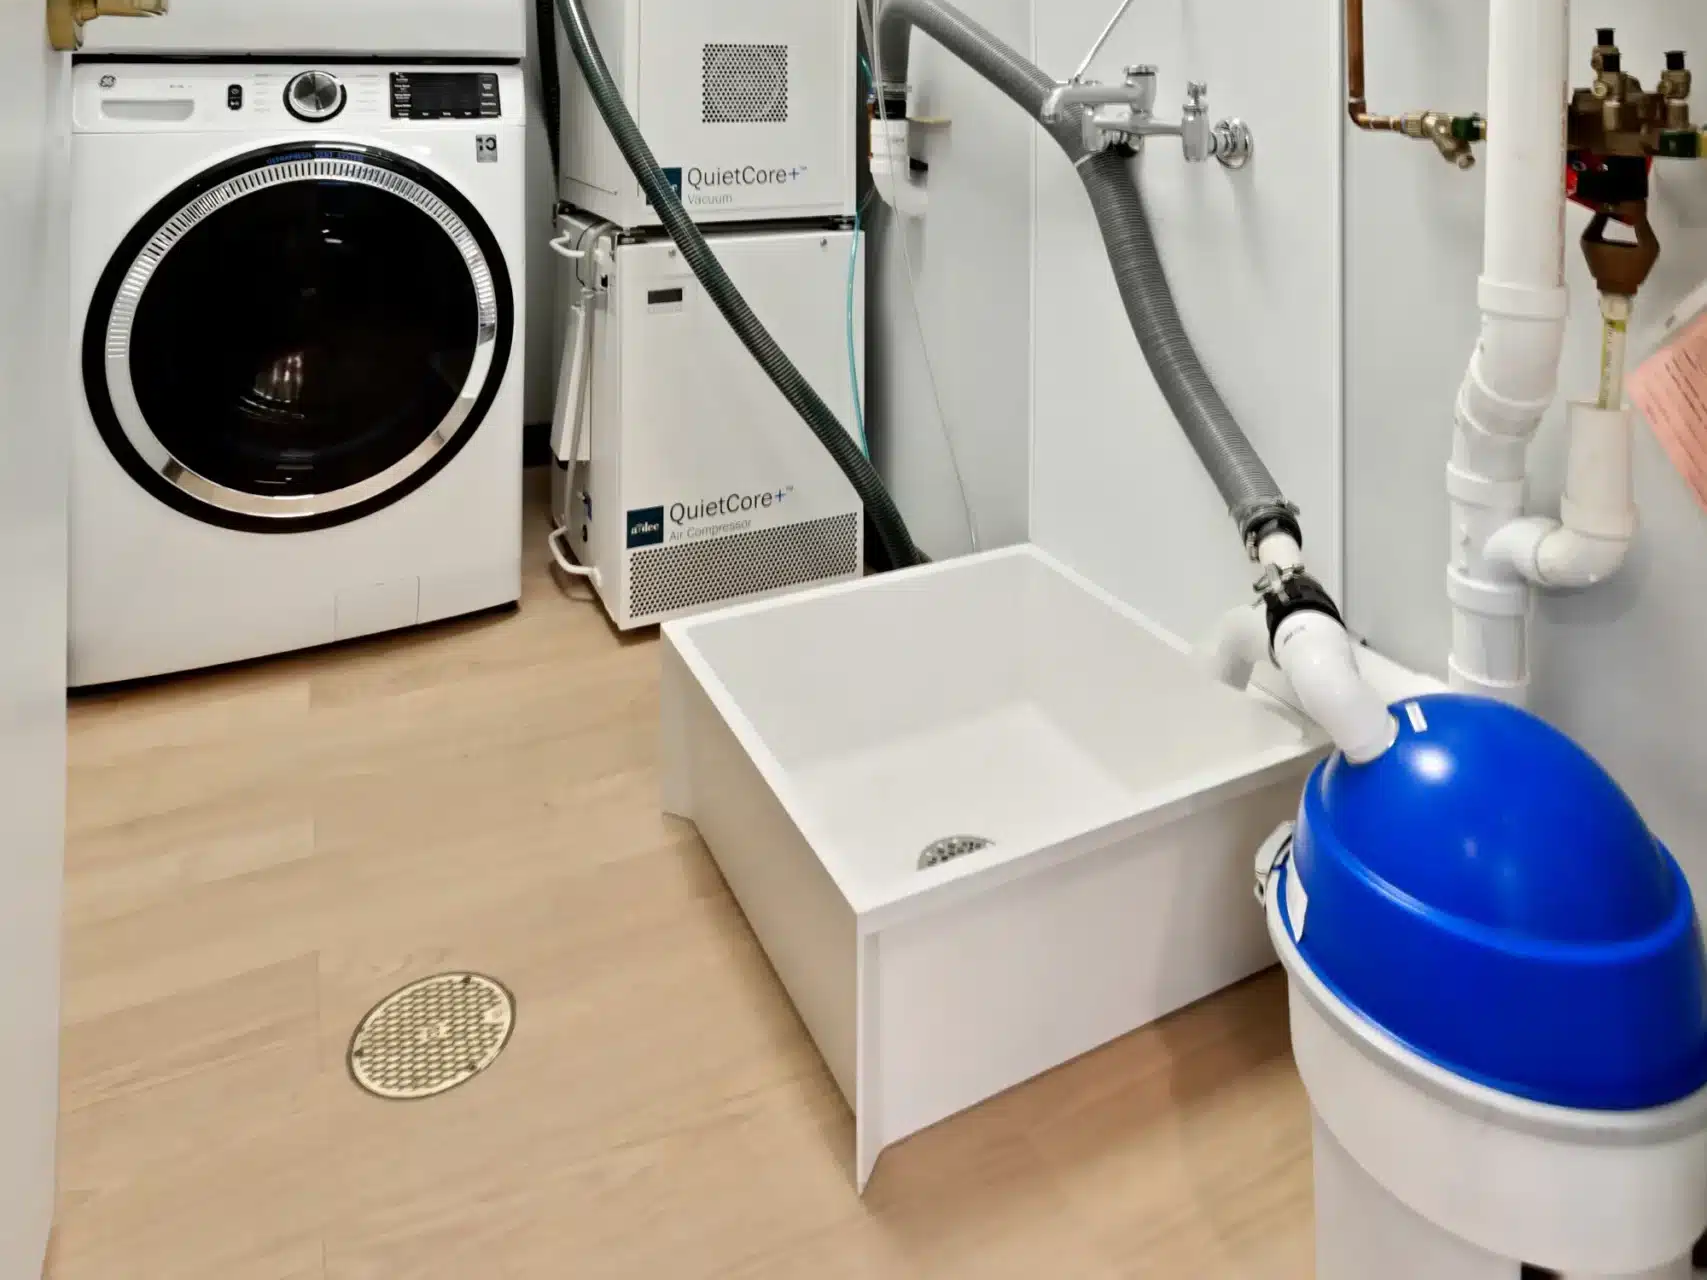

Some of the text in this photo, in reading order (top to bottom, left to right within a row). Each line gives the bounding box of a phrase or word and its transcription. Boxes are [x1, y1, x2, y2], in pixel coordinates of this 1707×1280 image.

[687, 194, 733, 205] Vacuum
[669, 519, 752, 542] Air Compressor
